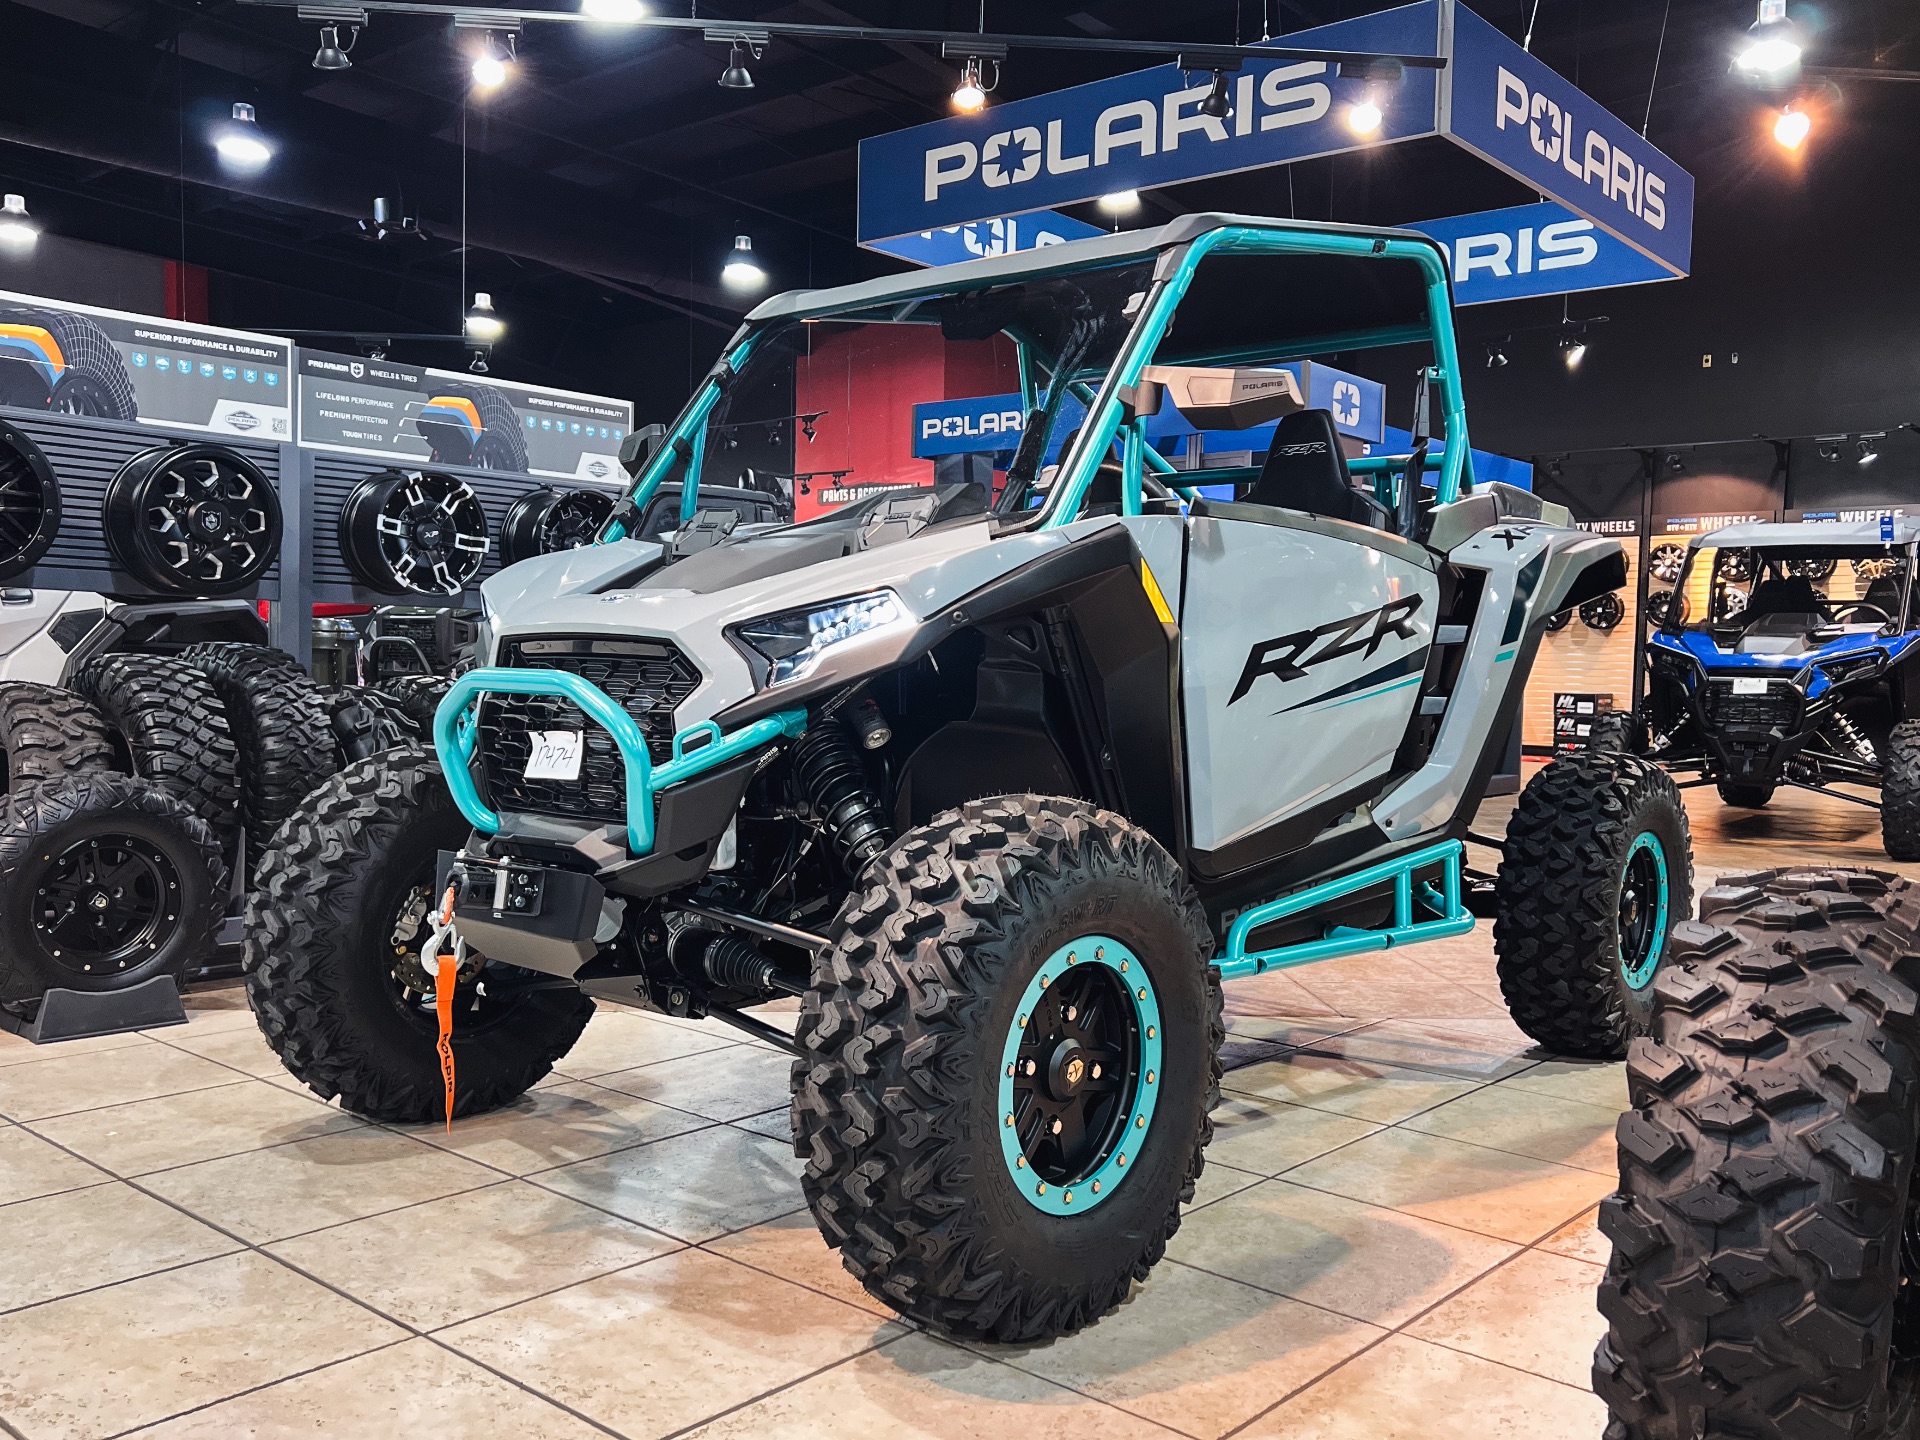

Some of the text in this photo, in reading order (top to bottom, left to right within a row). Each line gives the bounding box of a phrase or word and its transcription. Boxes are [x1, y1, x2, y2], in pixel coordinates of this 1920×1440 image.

[924, 61, 1331, 201] POLARIS
[1496, 65, 1667, 231] POLARIS
[134, 329, 278, 358] SUPERIOR PERFORMANCE & DURABILITY
[369, 369, 395, 379] WHEELS
[400, 374, 418, 383] TIRES
[1242, 381, 1283, 391] POLARIS
[315, 391, 394, 409] LIFELONG PERFORMANCE
[528, 397, 554, 407] SUPERIOR
[553, 401, 590, 413] PERFORMANCE
[594, 408, 623, 418] DURABILITY
[319, 409, 389, 425] PREMIUM PROTECTION
[342, 430, 363, 439] TOUGH
[363, 433, 383, 441] TIRES
[424, 530, 439, 538] XP
[1591, 520, 1636, 534] WHEELS
[1226, 593, 1424, 708] RZR
[1556, 694, 1576, 709] HL
[1556, 717, 1576, 732] HL
[442, 1032, 454, 1093] KOLPIN
